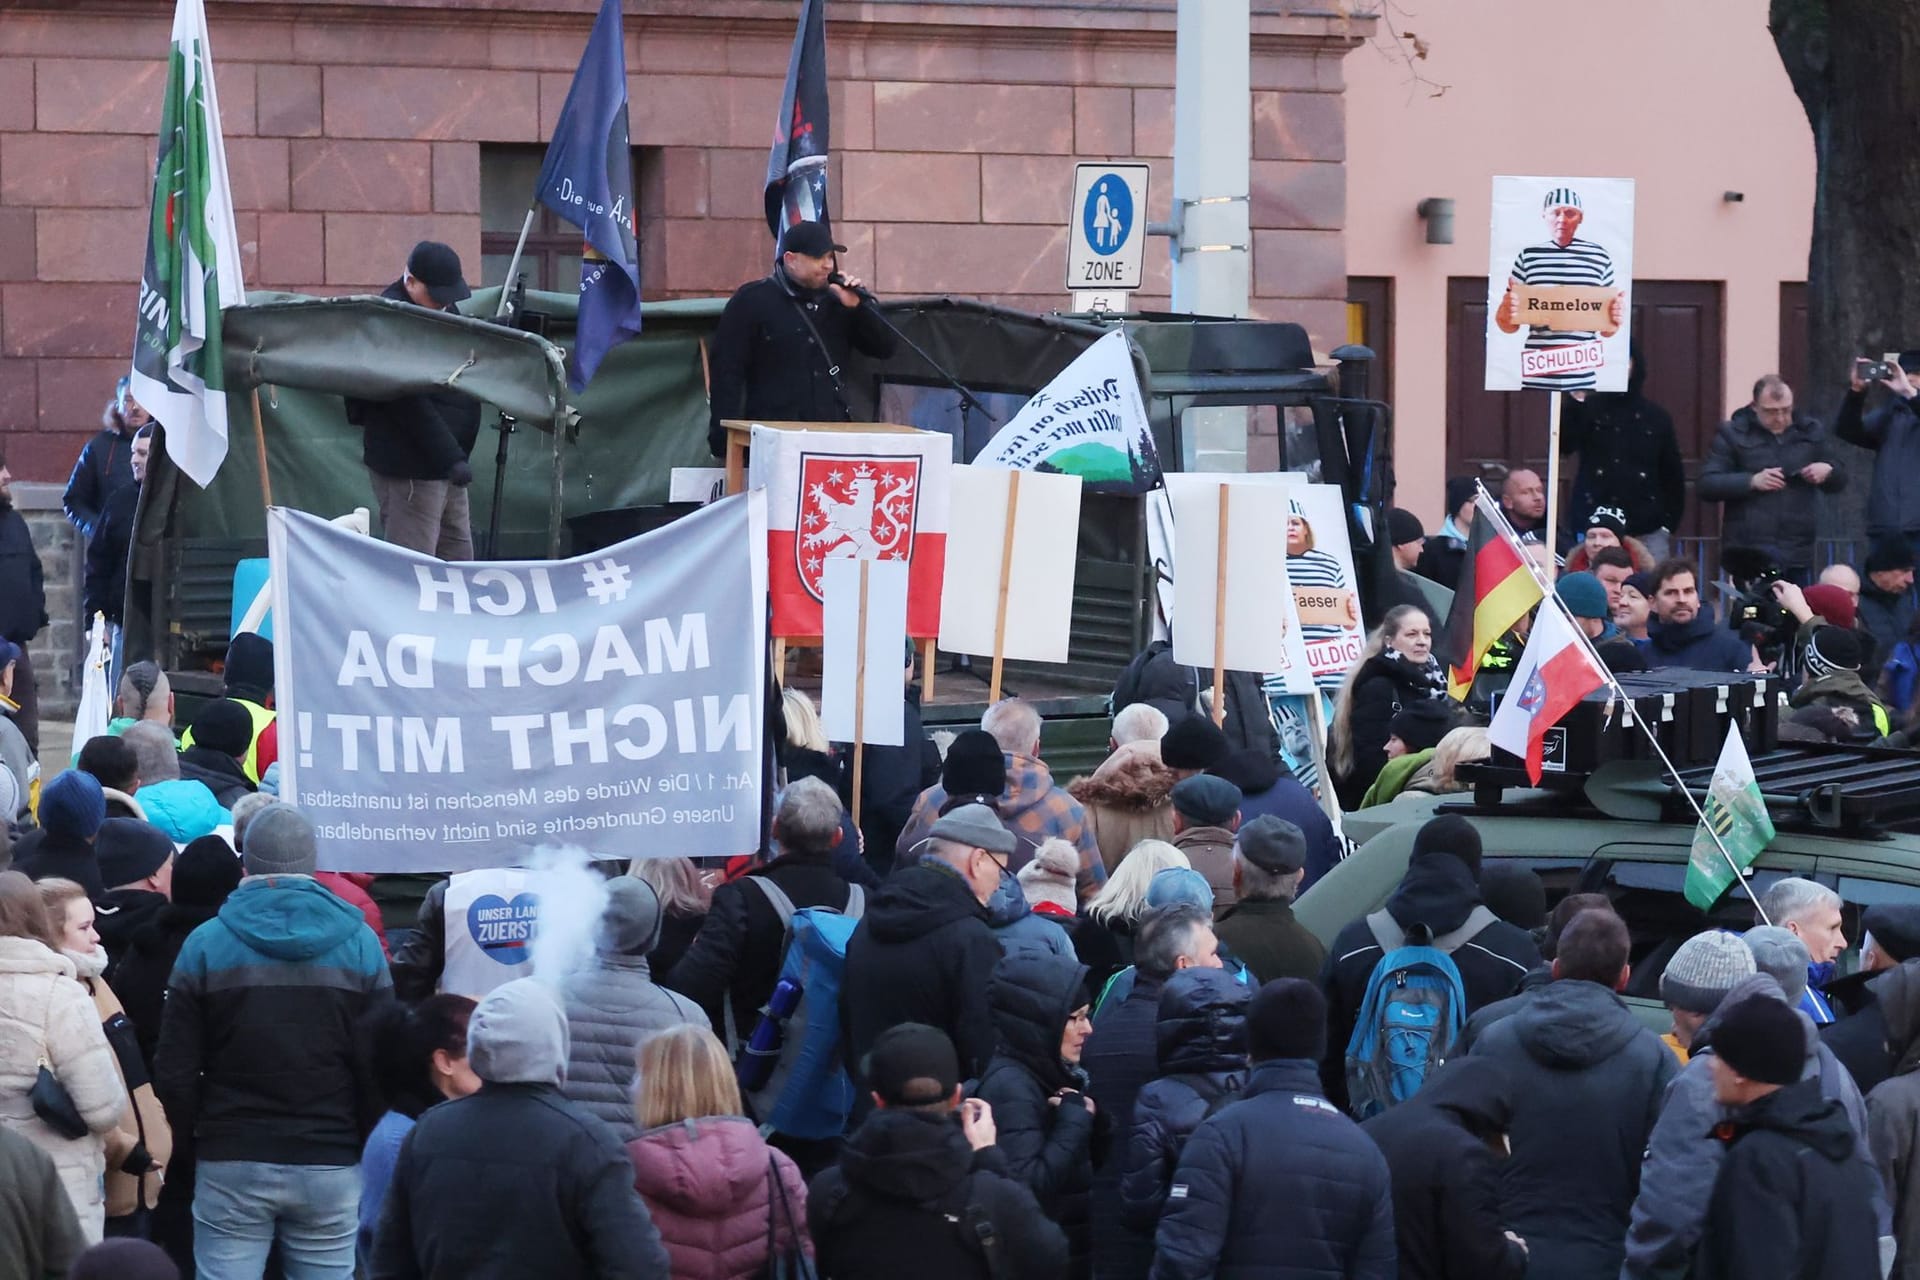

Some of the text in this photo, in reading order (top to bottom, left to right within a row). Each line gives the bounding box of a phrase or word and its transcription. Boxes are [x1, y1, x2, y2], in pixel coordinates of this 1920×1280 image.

[609, 195, 632, 230] Ära
[1085, 261, 1123, 280] ZONE
[1527, 297, 1603, 312] Ramelow
[1527, 347, 1598, 371] SCHULDIG
[1305, 643, 1359, 667] ULDIG
[478, 905, 538, 921] UNSER LAN
[478, 920, 537, 942] ZUERST
